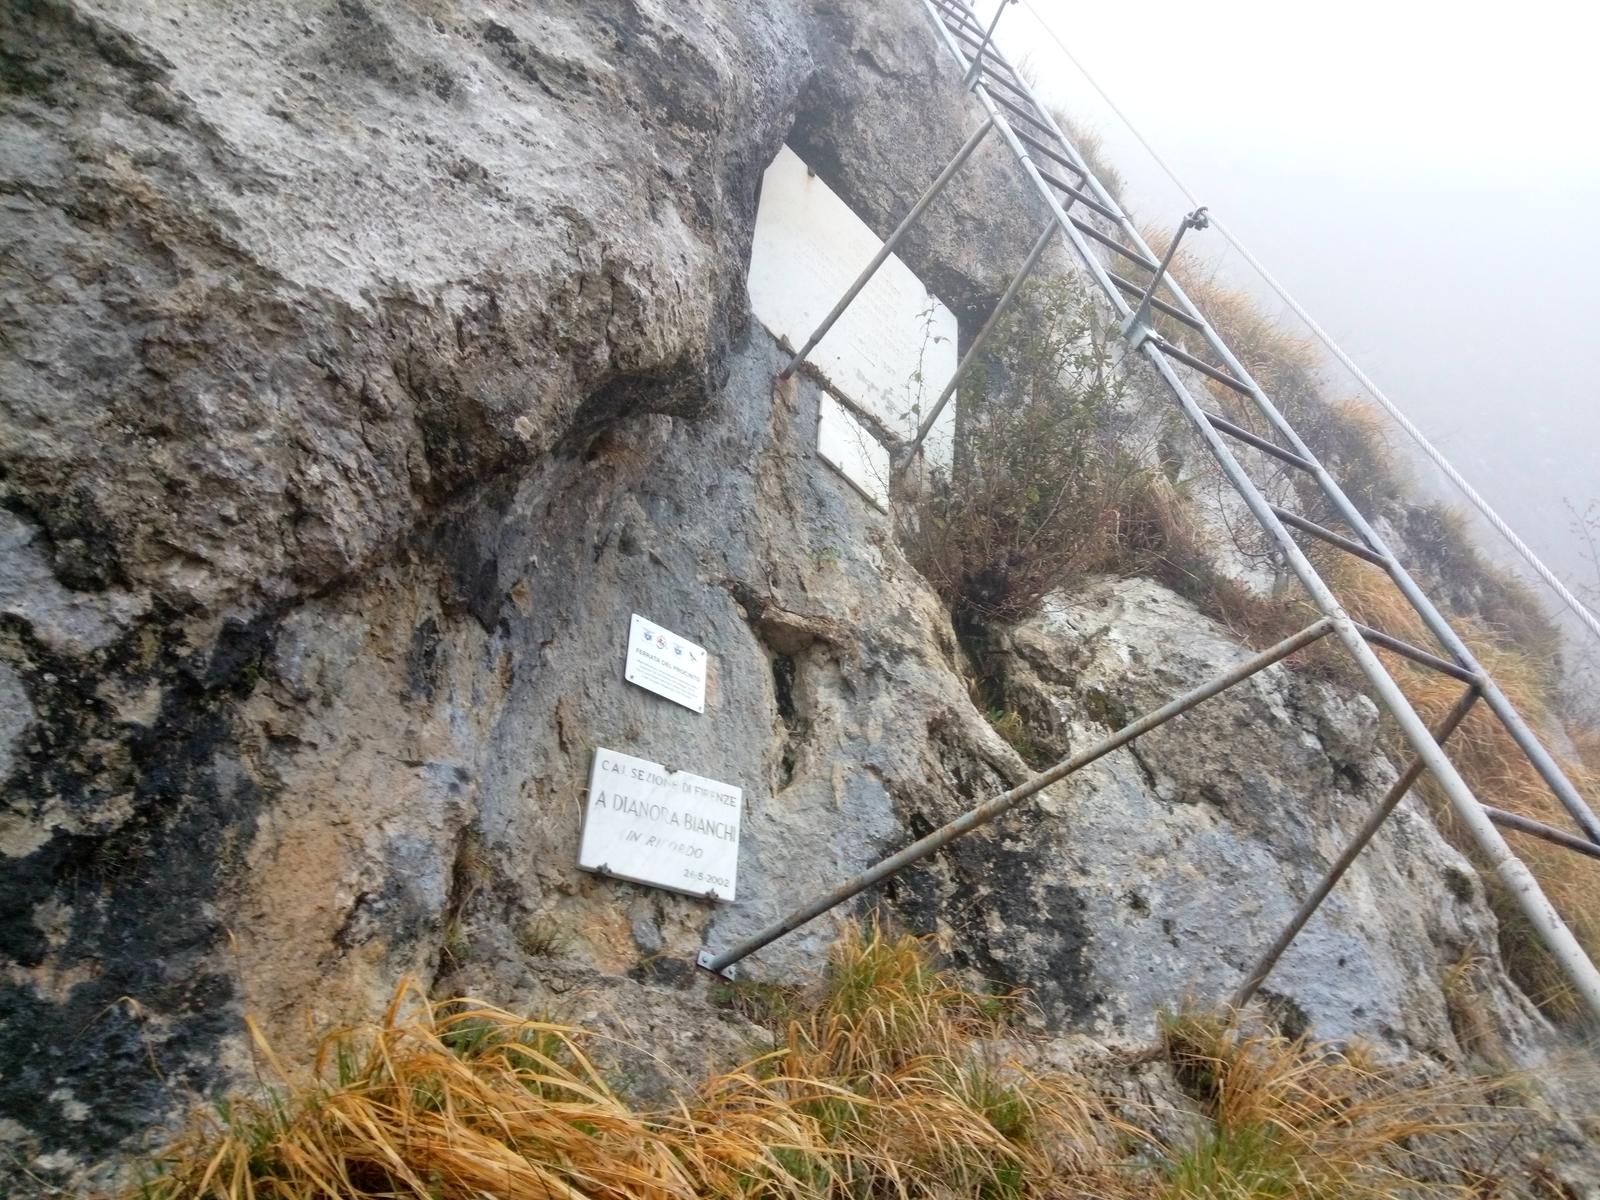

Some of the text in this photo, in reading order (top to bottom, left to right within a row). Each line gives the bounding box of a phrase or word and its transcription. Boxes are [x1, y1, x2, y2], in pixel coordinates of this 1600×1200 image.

[682, 782, 692, 794] DI
[595, 789, 736, 842] A DIANORA BIANCHI
[625, 830, 642, 843] IN
